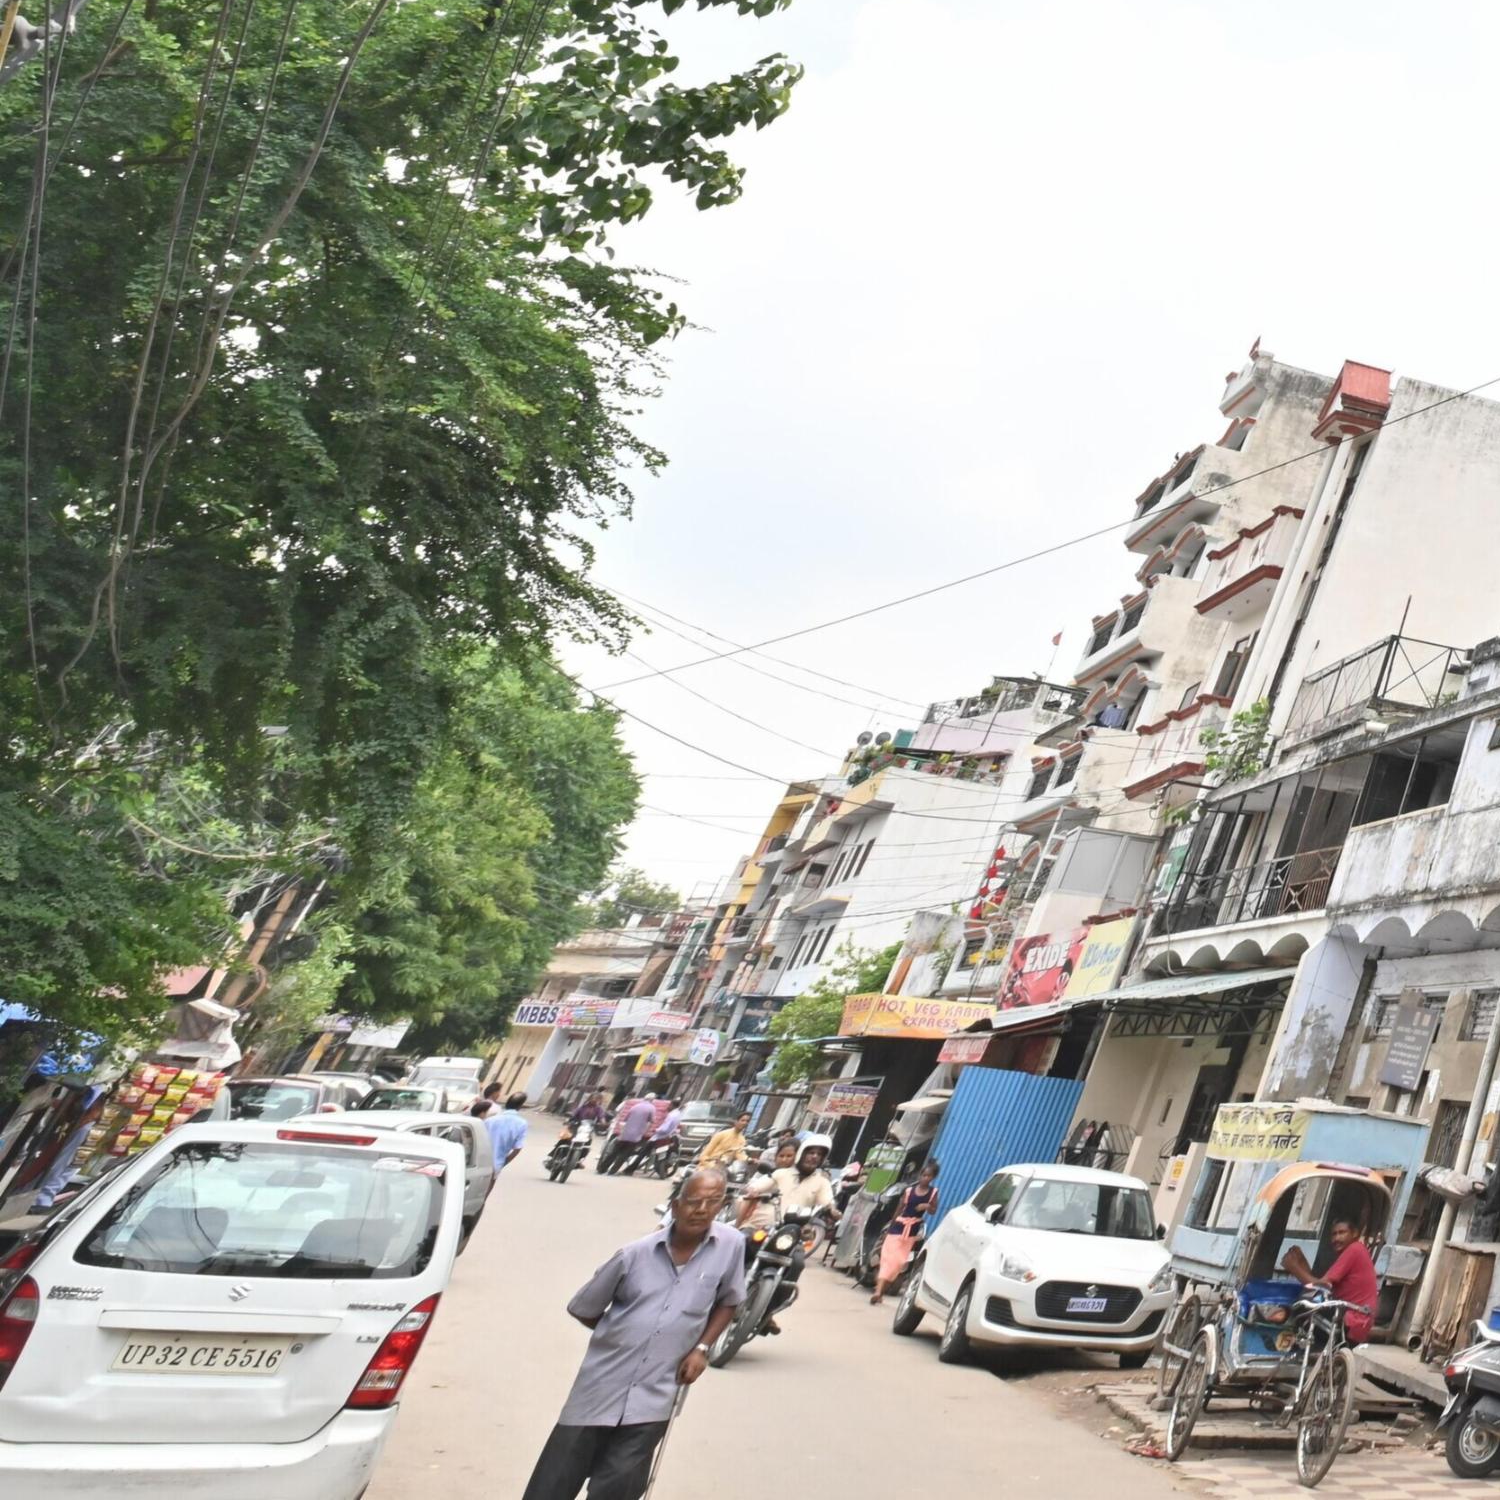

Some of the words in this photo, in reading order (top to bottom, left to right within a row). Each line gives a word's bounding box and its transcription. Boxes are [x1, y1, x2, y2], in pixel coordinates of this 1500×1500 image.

[1022, 941, 1071, 974] EXIDE
[515, 1006, 560, 1024] MBBS
[914, 1003, 941, 1015] VEG
[189, 1347, 224, 1367] CE
[224, 1348, 282, 1369] 5516
